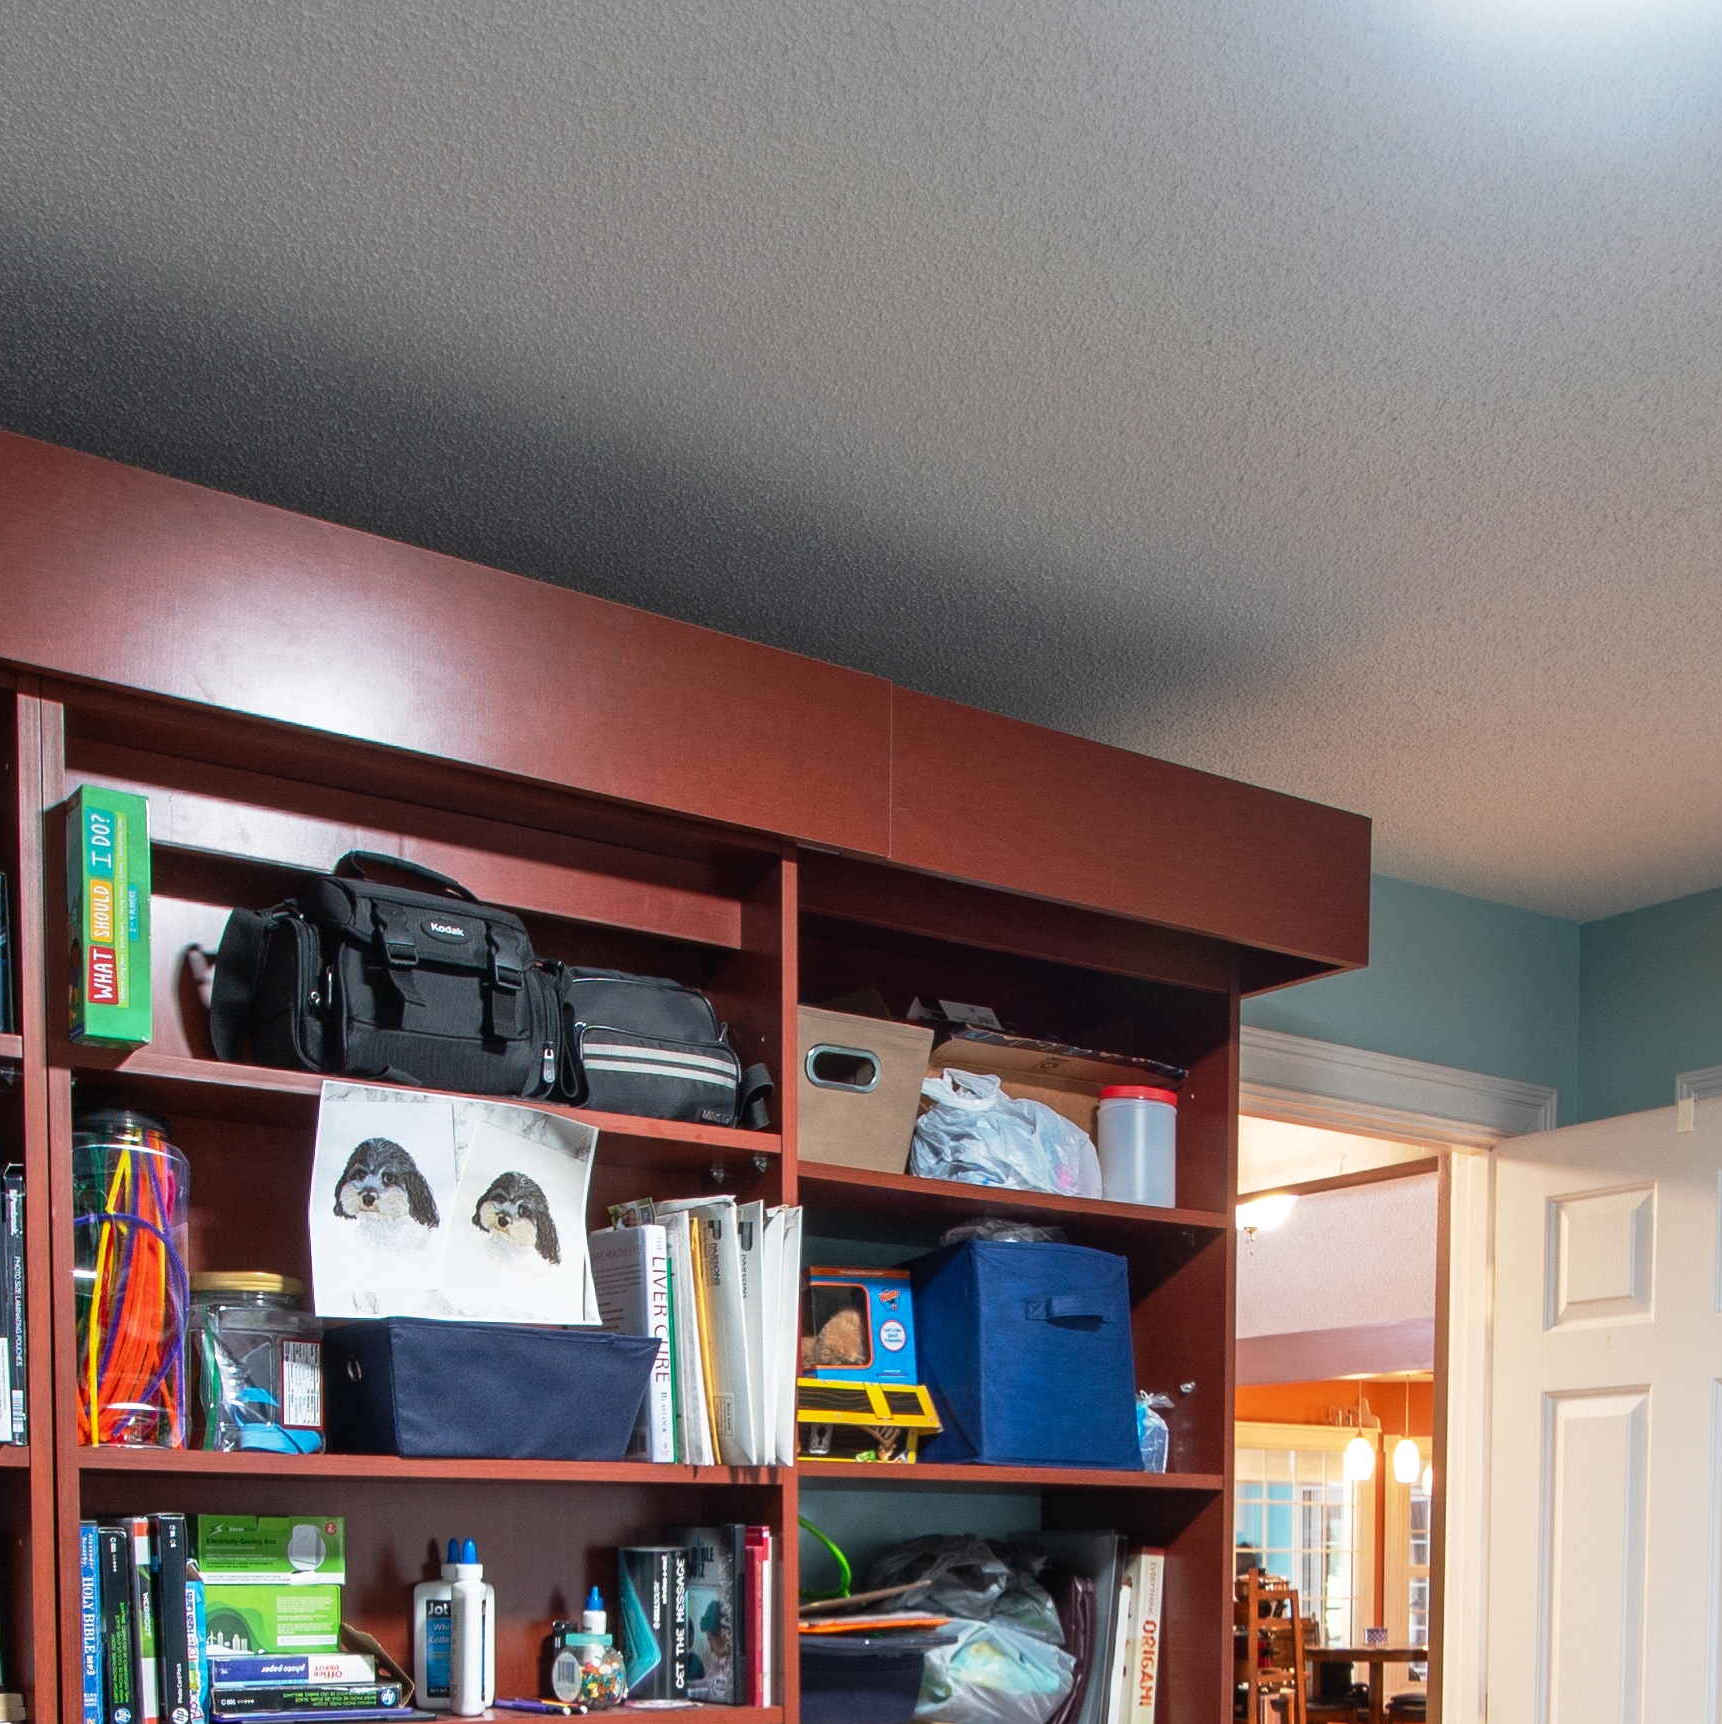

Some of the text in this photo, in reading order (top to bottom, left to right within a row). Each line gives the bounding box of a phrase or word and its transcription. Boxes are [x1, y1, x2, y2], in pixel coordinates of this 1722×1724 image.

[91, 814, 113, 999] WHAT SHOULD I DO?
[430, 920, 465, 937] Kodak
[206, 1538, 261, 1546] Electricity-Saving
[82, 1577, 95, 1675] HOLY BIBLE MP3
[143, 1592, 151, 1637] WEBROOT
[676, 1559, 685, 1688] GET THE MESSAGE
[1138, 1562, 1157, 1707] EVERYTHING ORIGAMI
[261, 1663, 305, 1673] photo paper
[313, 1671, 342, 1679] Office
